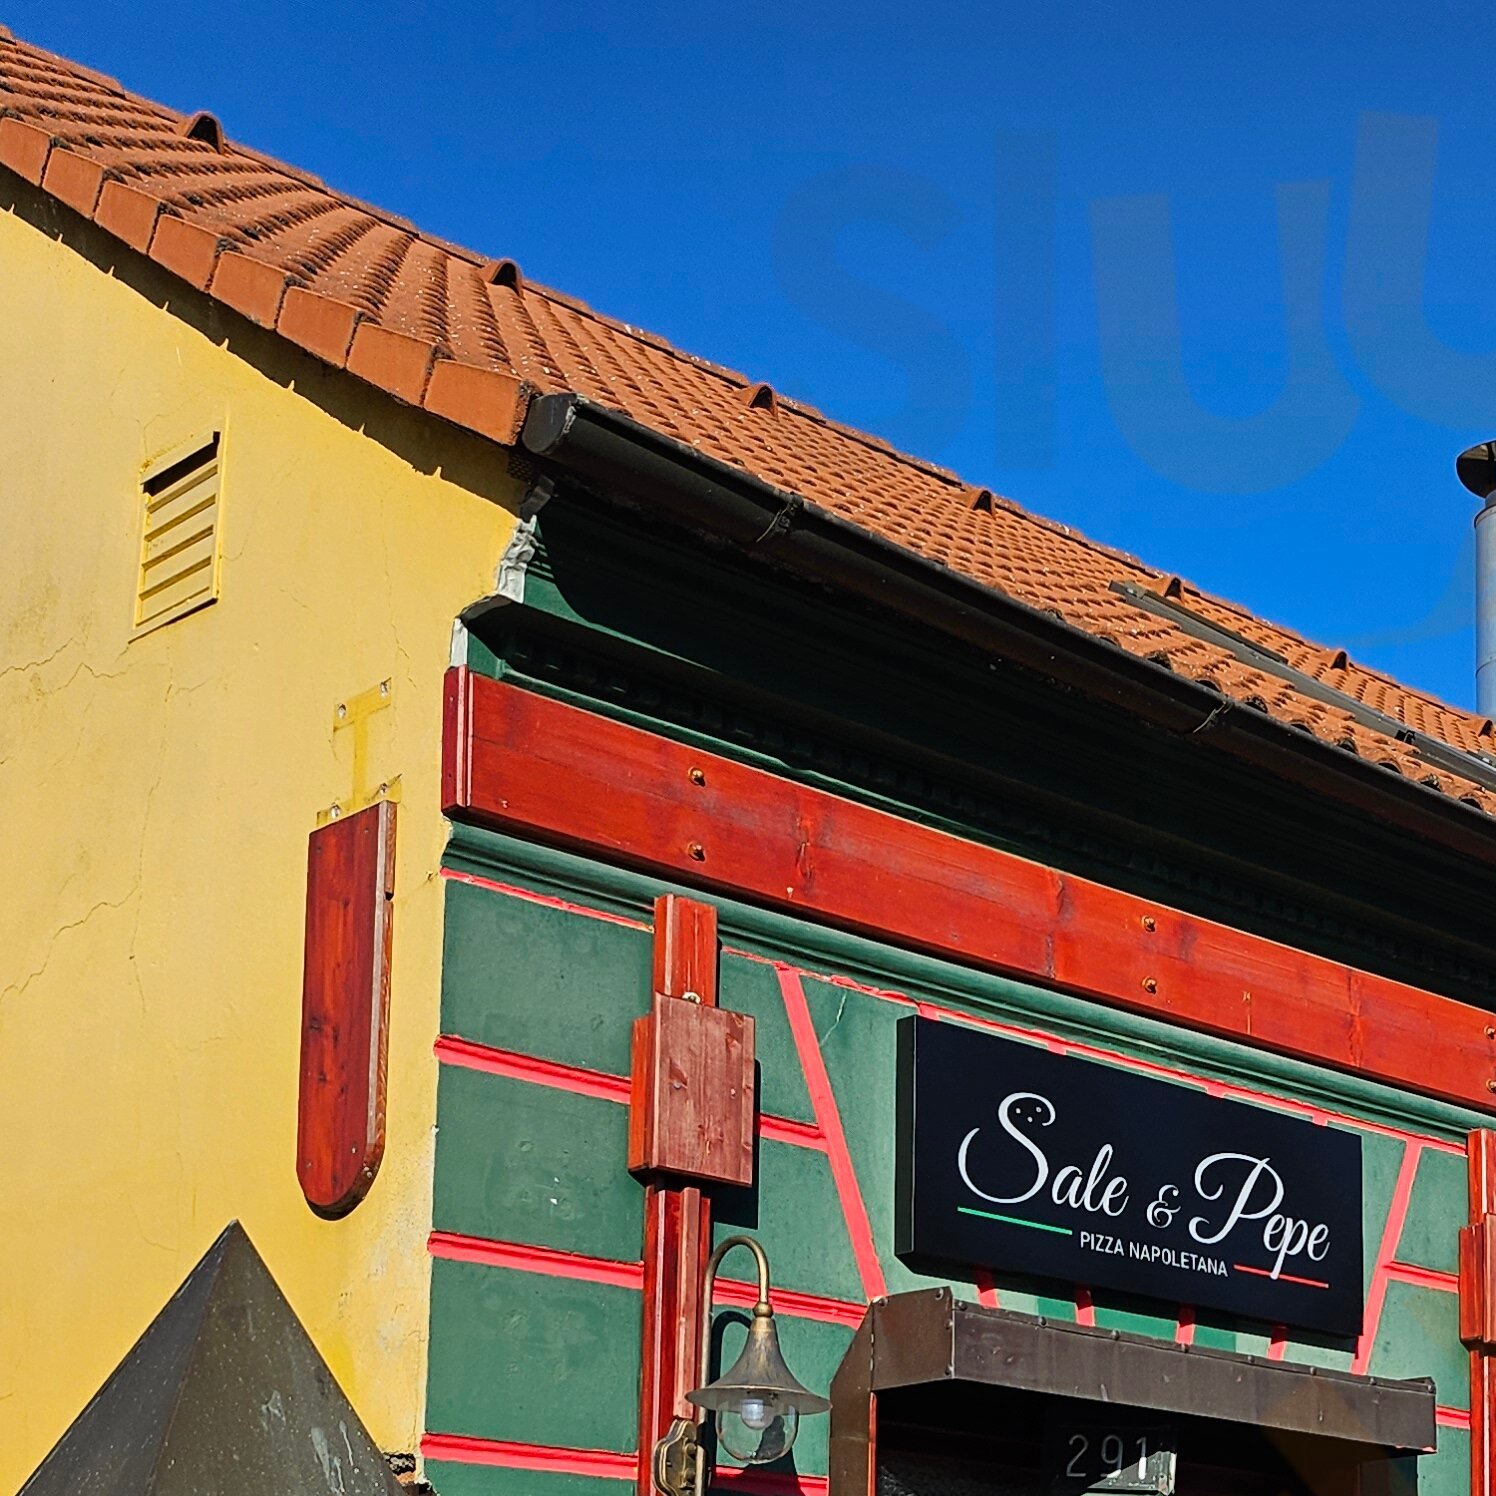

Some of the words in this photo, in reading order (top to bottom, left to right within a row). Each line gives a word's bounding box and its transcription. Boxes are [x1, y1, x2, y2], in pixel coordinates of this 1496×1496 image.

[957, 1092, 1129, 1218] Sale
[1146, 1184, 1181, 1228] &
[1188, 1152, 1331, 1280] Pepe
[1080, 1231, 1125, 1256] PIZZA
[1129, 1239, 1229, 1278] NAPOLETANA
[1066, 1434, 1148, 1480] 291
